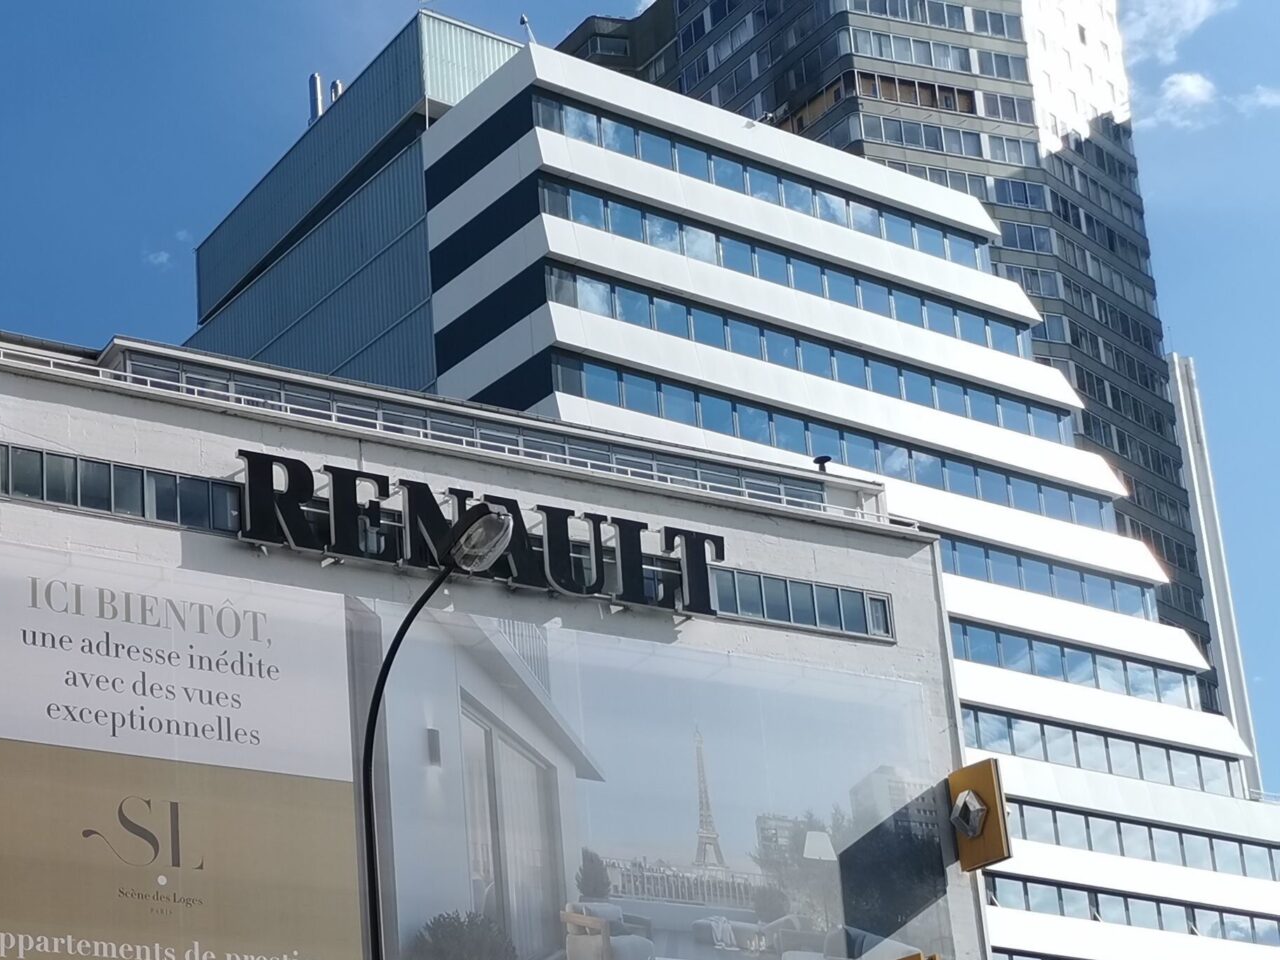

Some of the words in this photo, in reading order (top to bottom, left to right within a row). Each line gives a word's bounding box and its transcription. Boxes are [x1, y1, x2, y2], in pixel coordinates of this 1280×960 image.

[236, 449, 724, 616] RENAULT
[27, 575, 85, 616] ICI
[95, 587, 272, 648] BIENTÔT,
[21, 628, 73, 652] une
[80, 631, 180, 667] adresse
[187, 644, 280, 681] inédite
[64, 669, 124, 693] avec
[132, 671, 176, 701] des
[181, 686, 242, 709] vues
[46, 701, 261, 746] exceptionnelles
[81, 795, 204, 871] SL
[152, 890, 171, 902] des
[173, 892, 204, 909] Loges
